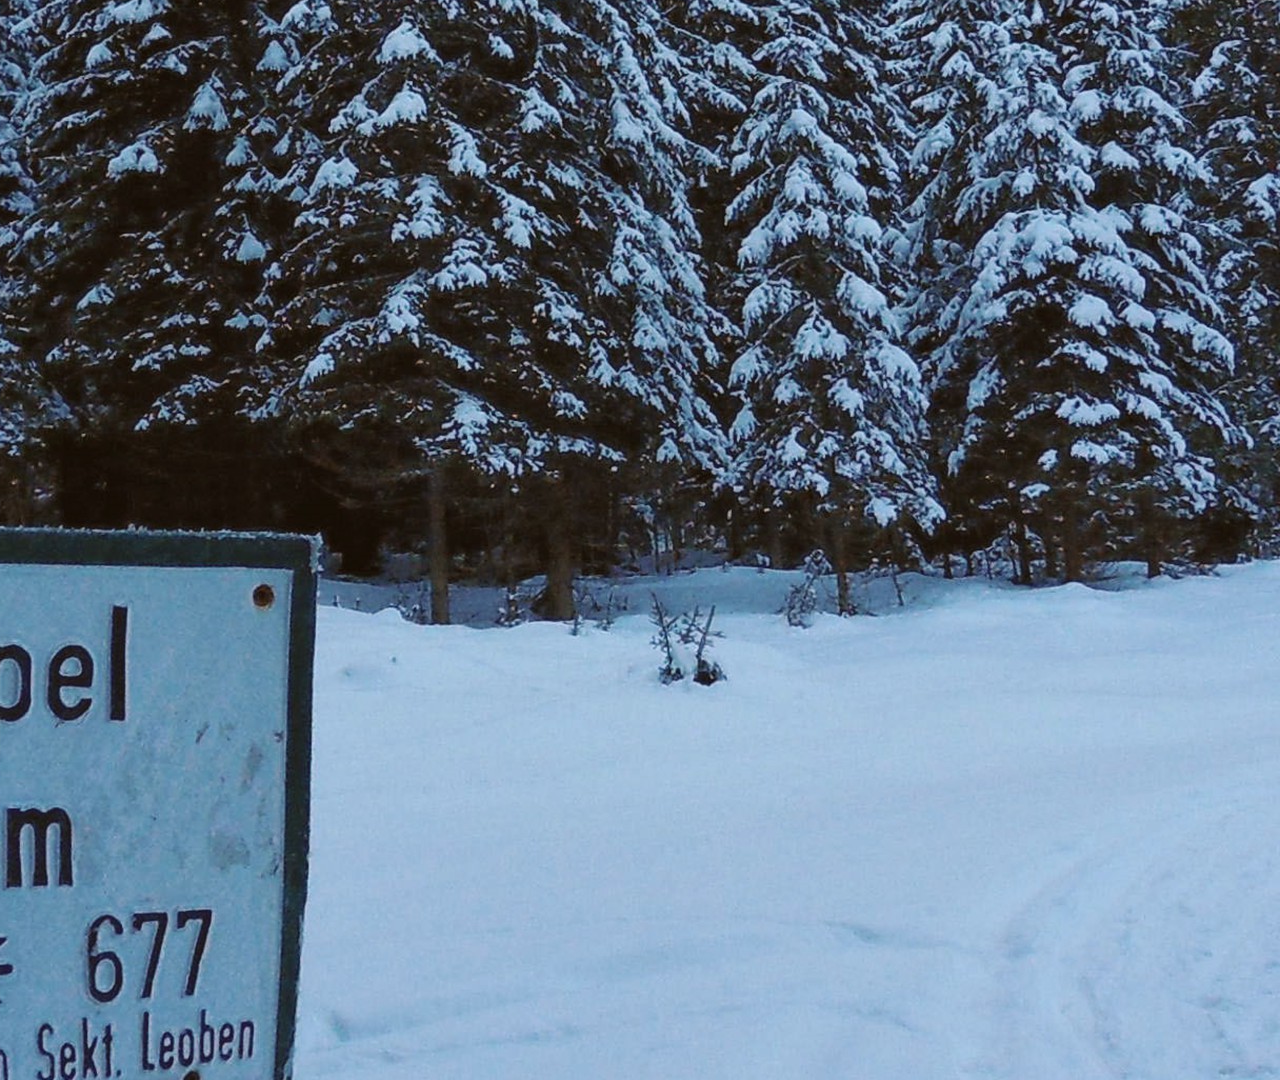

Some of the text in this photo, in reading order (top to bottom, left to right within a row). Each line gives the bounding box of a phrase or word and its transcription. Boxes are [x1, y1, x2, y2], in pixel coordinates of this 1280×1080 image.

[86, 909, 212, 1002] 677
[36, 1017, 122, 1080] Sekt.
[141, 1009, 255, 1070] Leoben
